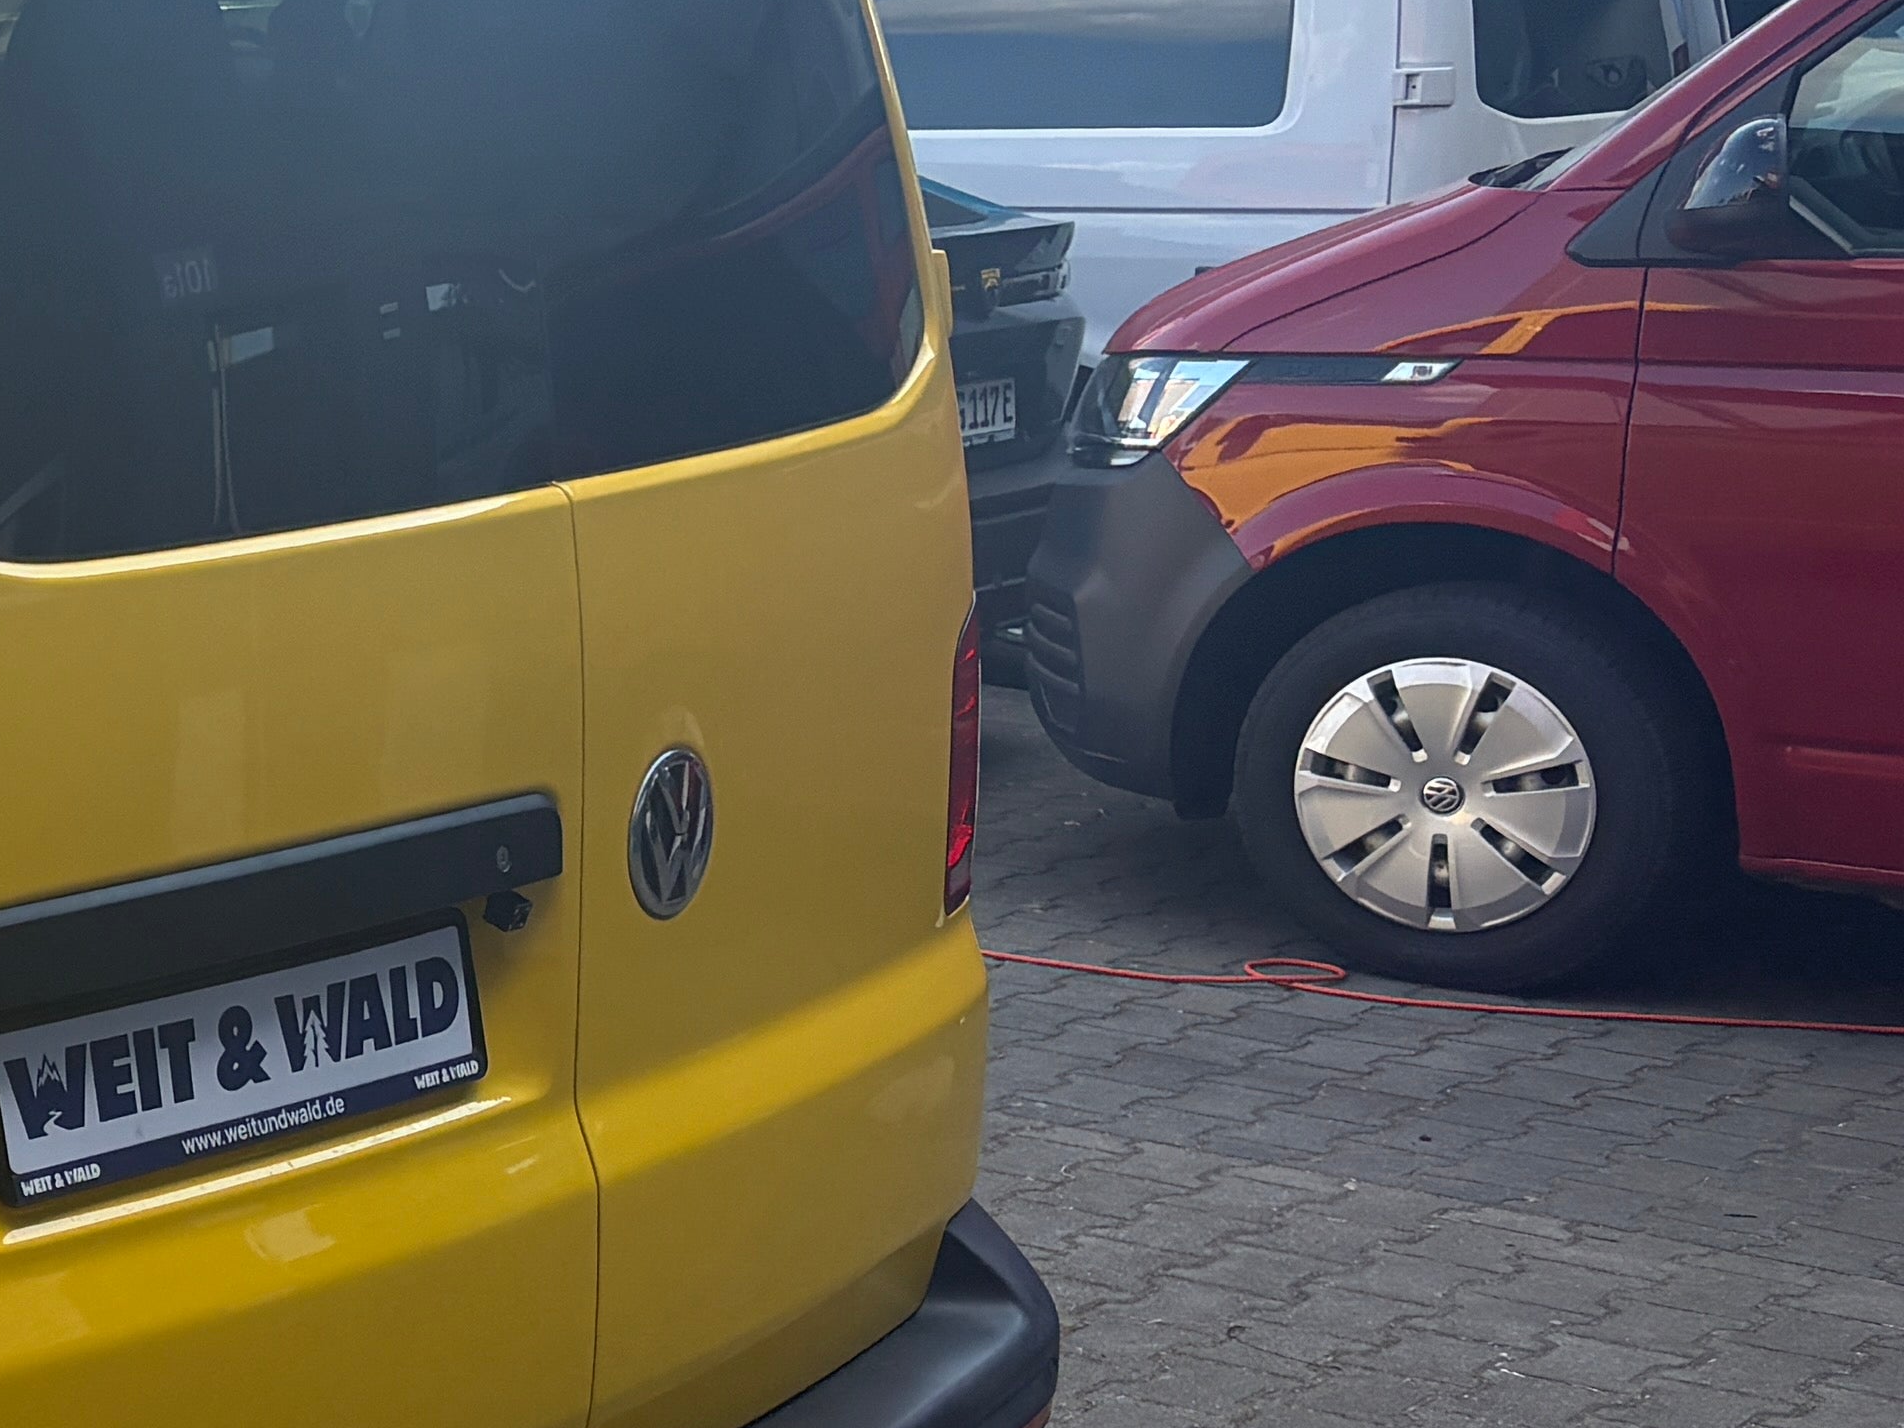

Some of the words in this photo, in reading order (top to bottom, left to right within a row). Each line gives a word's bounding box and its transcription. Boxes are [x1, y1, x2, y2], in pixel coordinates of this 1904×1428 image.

[3, 1018, 196, 1140] WEIT
[216, 1005, 271, 1092] &
[274, 955, 460, 1073] WALD
[413, 1069, 440, 1090] WEIT
[441, 1067, 450, 1083] &
[449, 1059, 479, 1080] WALD
[181, 1096, 345, 1155] www.weitundwald.de
[20, 1175, 52, 1197] WEIT
[54, 1172, 65, 1188] &
[64, 1163, 101, 1185] WALD
